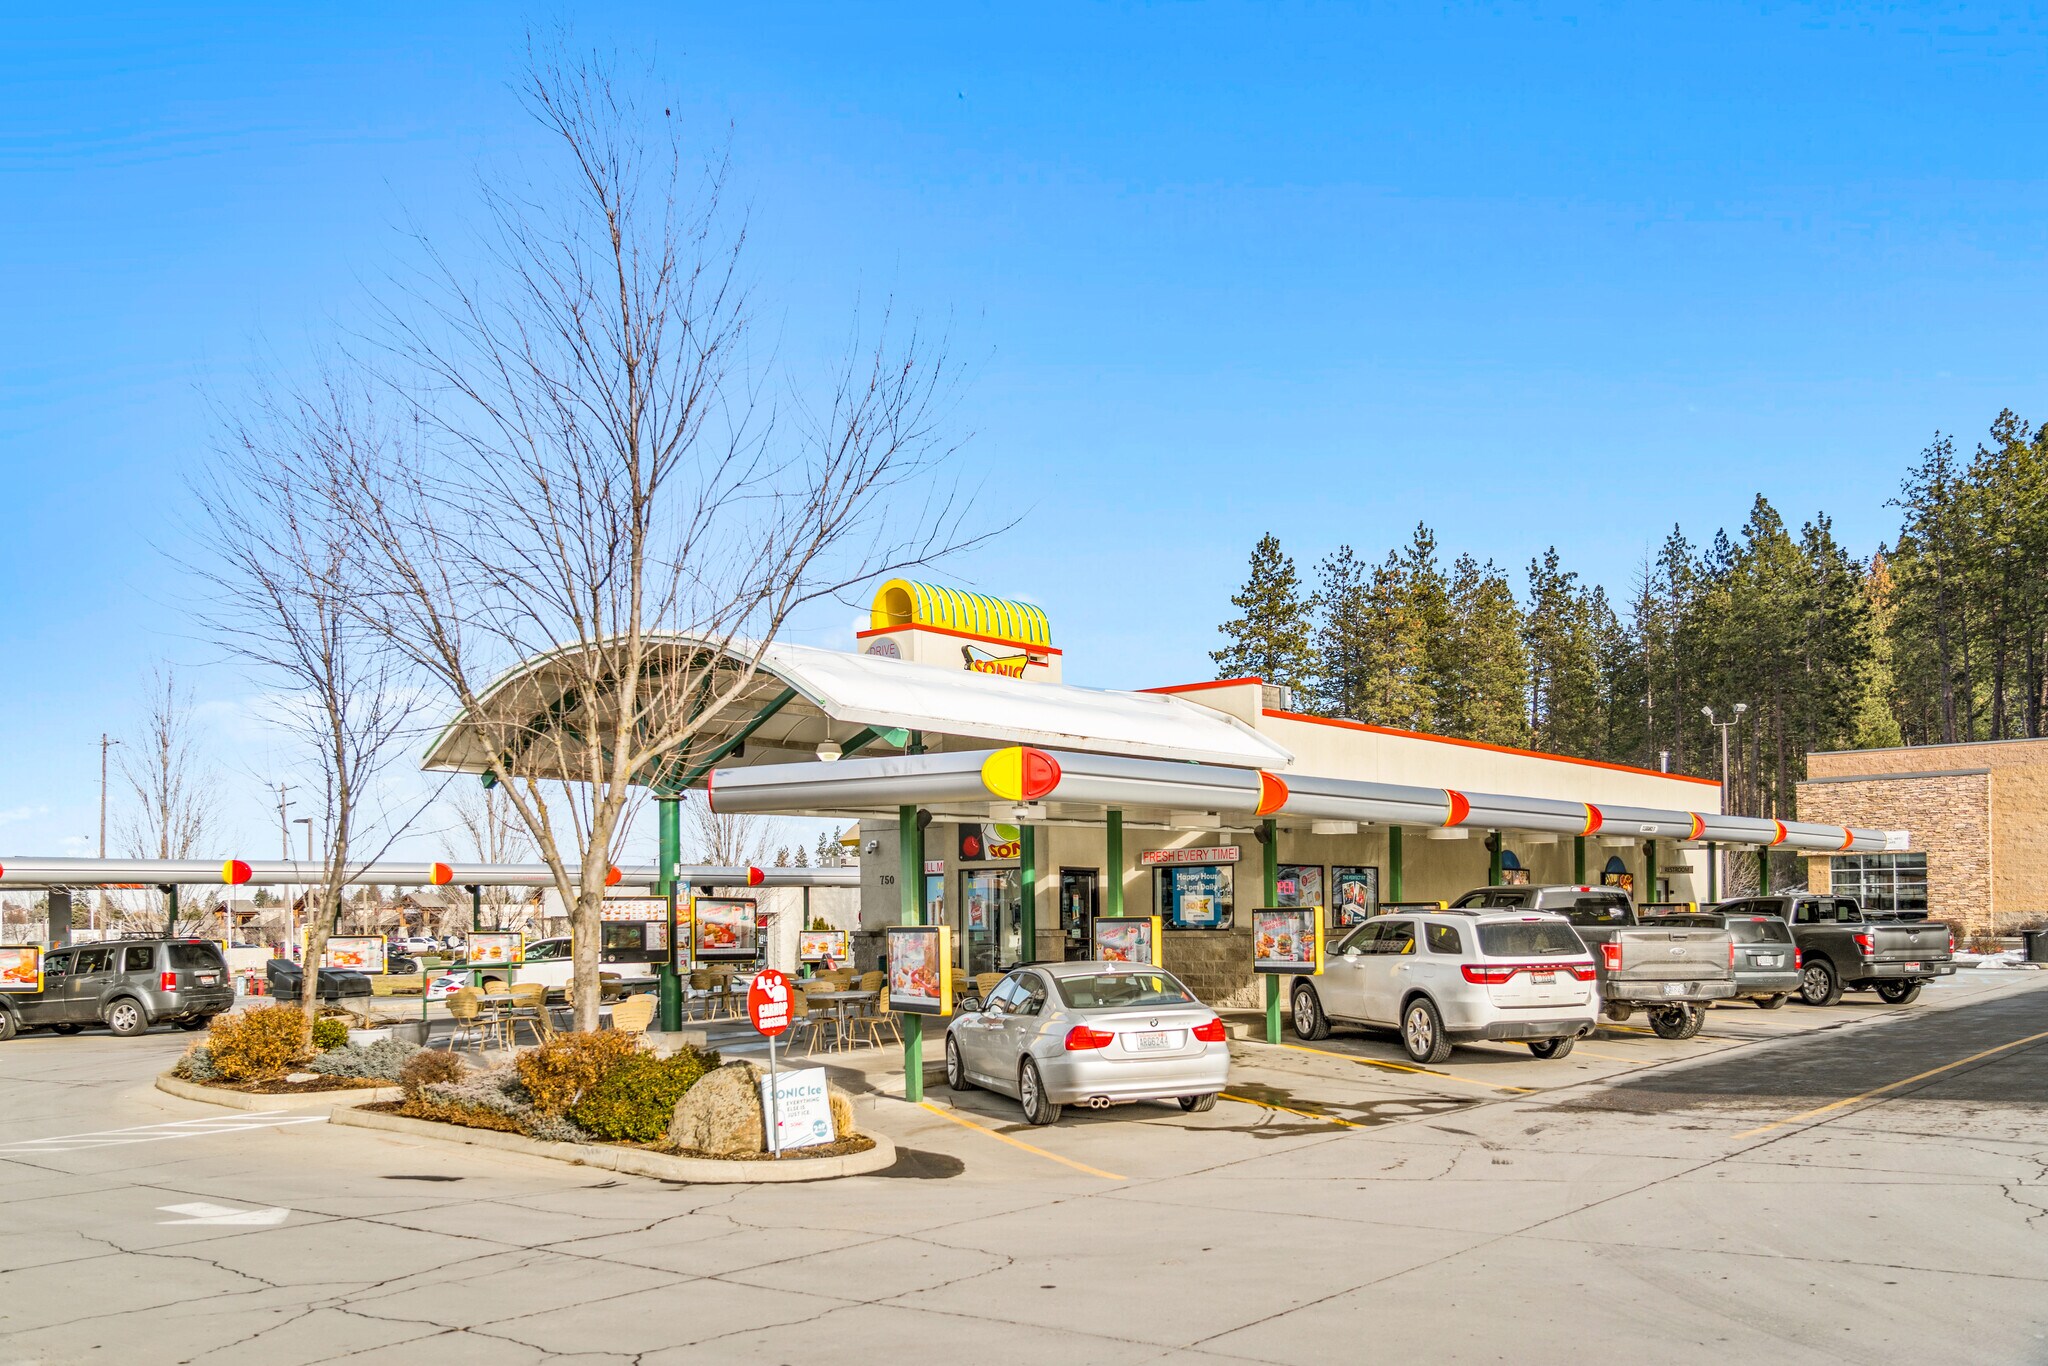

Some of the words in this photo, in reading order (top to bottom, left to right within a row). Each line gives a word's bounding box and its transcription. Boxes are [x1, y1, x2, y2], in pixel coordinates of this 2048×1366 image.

[870, 643, 895, 656] DRIVE
[1143, 851, 1175, 863] FRESH
[1177, 849, 1209, 861] EVERY
[1212, 848, 1238, 859] TIME!
[879, 875, 895, 885] 750
[1176, 873, 1200, 882] Happy
[1200, 872, 1218, 880] Hour
[758, 1001, 788, 1018] CARHOP
[808, 1085, 822, 1095] Ice
[786, 1097, 820, 1106] EVERYTHING
